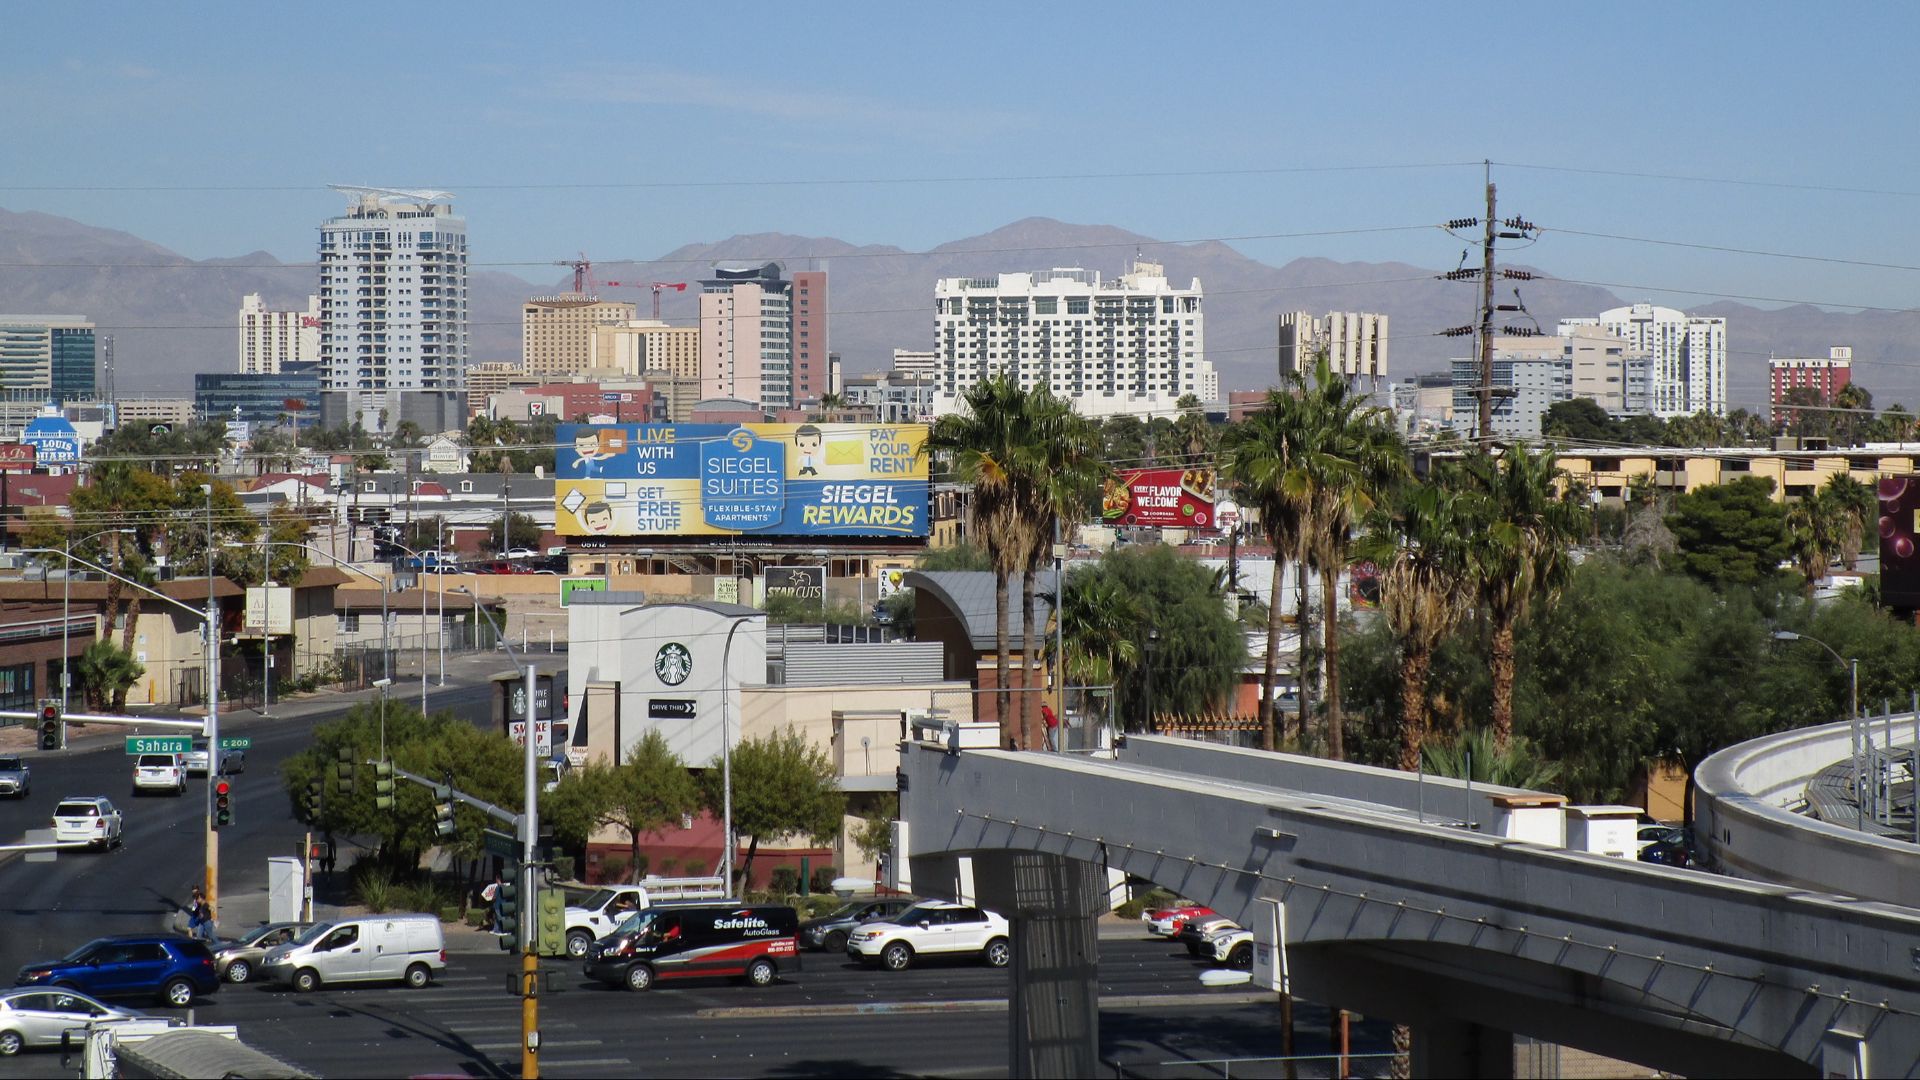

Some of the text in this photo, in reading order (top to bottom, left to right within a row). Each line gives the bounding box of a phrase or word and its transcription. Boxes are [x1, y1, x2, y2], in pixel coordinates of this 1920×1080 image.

[530, 295, 562, 303] GOLDEN
[637, 428, 676, 444] LIVE
[869, 428, 898, 442] PAY
[42, 439, 73, 452] LOUIS
[870, 442, 910, 456] YOUR
[637, 446, 674, 459] WITH
[637, 461, 656, 475] US
[708, 457, 778, 474] SIEGEL
[869, 457, 915, 473] RENT
[637, 486, 665, 499] GET
[707, 478, 779, 495] SUITES
[1133, 485, 1182, 497] EVERY FLAVOR
[820, 485, 898, 504] SIEGEL
[1137, 496, 1179, 508] WELCOME
[637, 501, 681, 517] FREE
[708, 505, 777, 513] FLEXIBLE-STAY
[802, 505, 915, 525] REWARDS
[637, 518, 681, 531] STUFF
[714, 514, 769, 522] APARTMENTS
[136, 740, 183, 752] Sahara
[230, 739, 249, 747] 200
[713, 918, 766, 930] Safelite
[743, 928, 780, 937] AutoGlass
